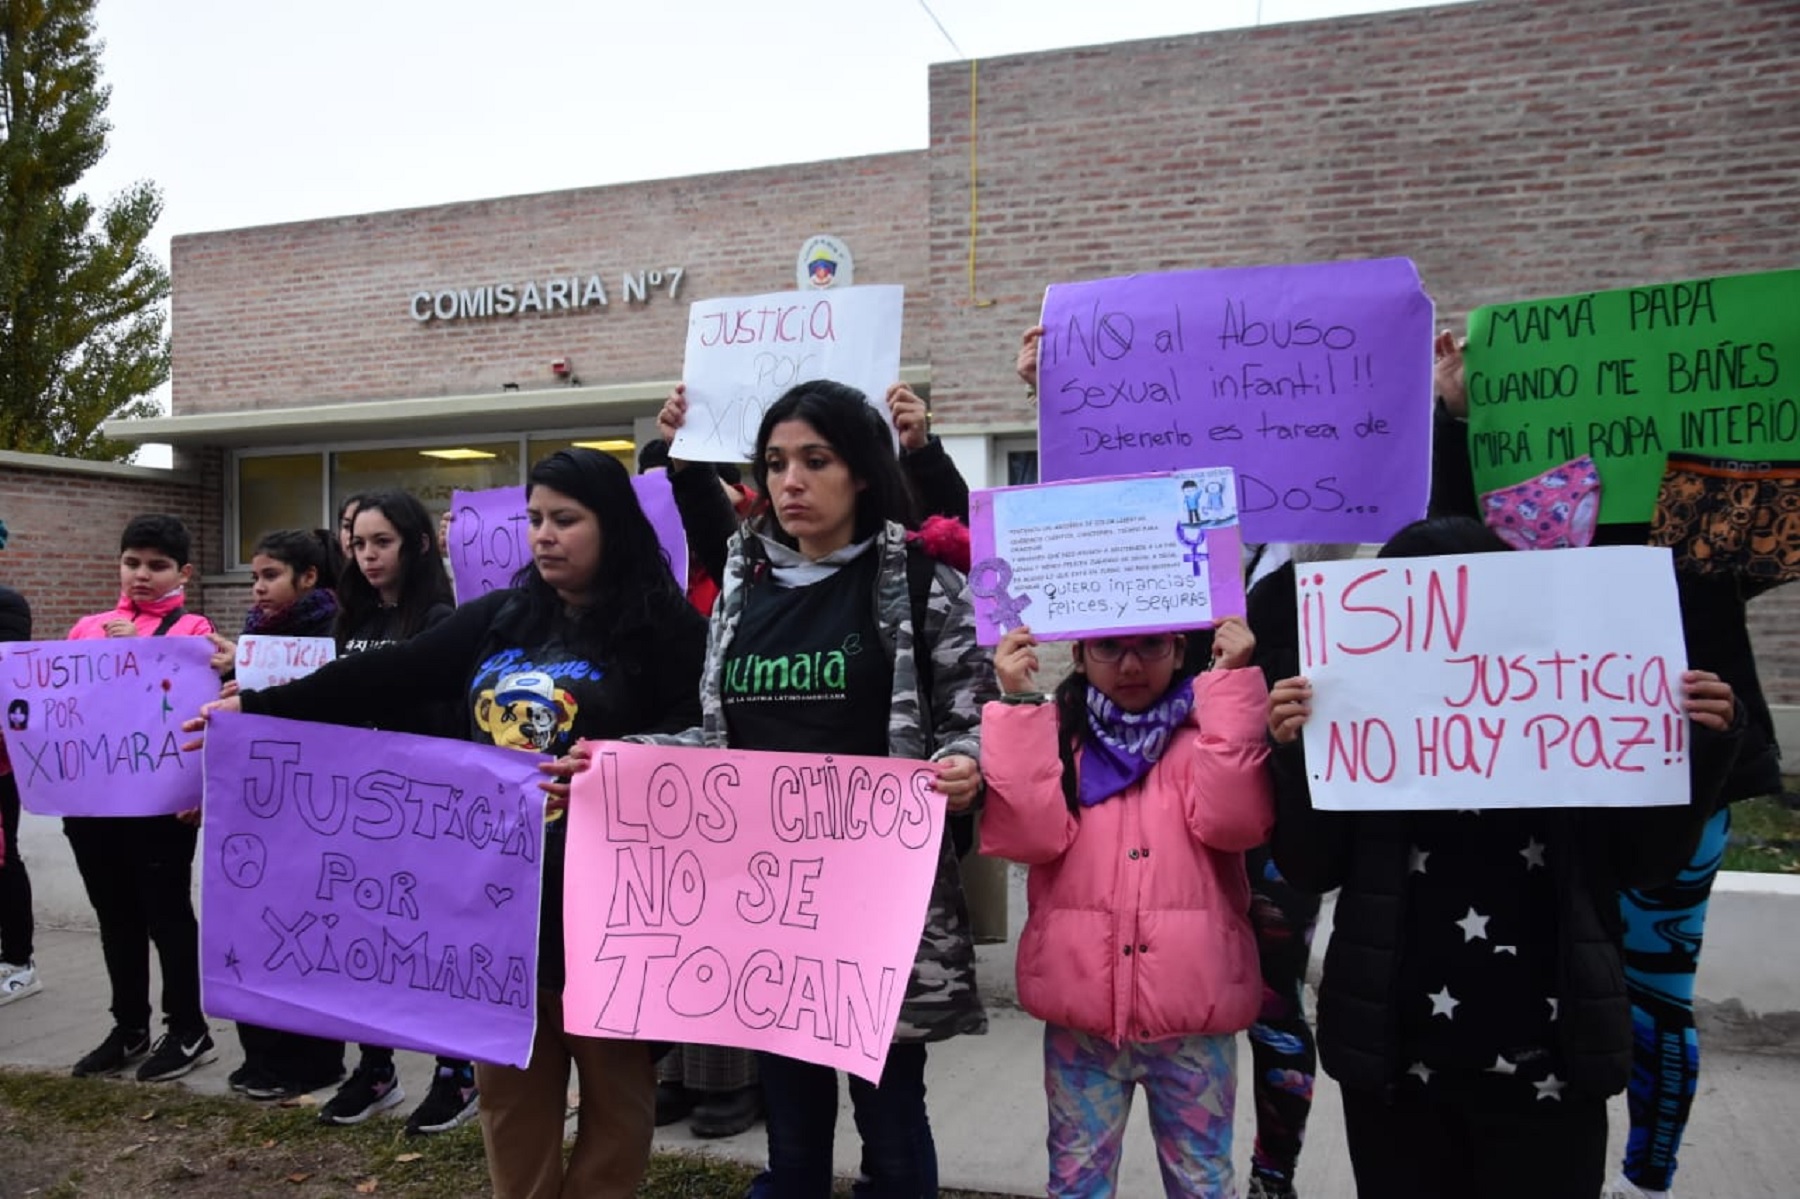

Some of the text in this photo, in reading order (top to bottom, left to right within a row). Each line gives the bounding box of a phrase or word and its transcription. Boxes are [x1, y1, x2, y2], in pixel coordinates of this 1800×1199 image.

[409, 275, 608, 322] COMISARIA
[1155, 303, 1184, 353] al
[1469, 340, 1780, 407] CUANDO ME BAÑES
[1078, 410, 1393, 456] Detenerlo es tarea de
[1588, 416, 1663, 459] ROPA
[12, 648, 141, 690] JUSTICIA
[43, 697, 85, 733] POR
[20, 731, 185, 789] XIOMARA
[1326, 717, 1397, 785] NO
[601, 751, 741, 844] LOS
[606, 846, 824, 930] NO SE
[594, 932, 897, 1062] TOCAN
